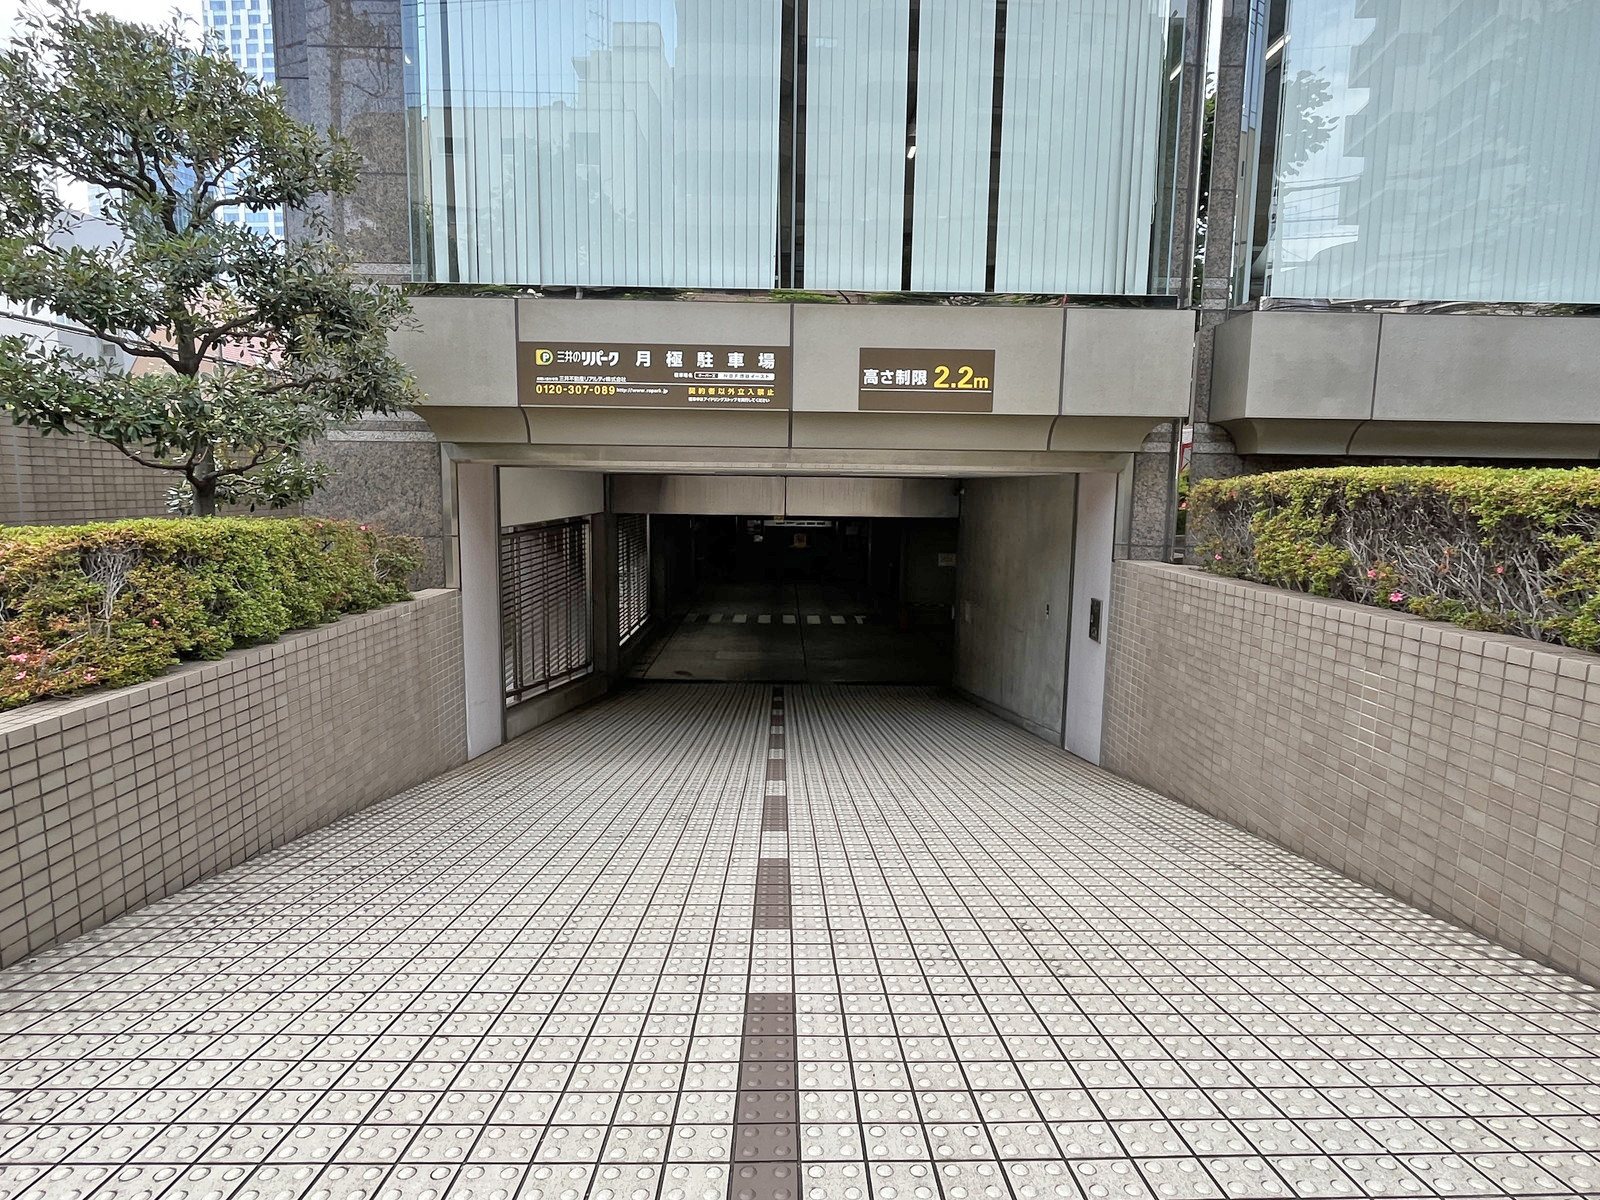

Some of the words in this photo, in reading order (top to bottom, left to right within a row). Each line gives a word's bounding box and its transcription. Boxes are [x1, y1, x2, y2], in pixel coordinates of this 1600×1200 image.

[557, 350, 619, 366] 三井のリパーク
[635, 350, 776, 369] 月極駐車場
[863, 368, 928, 386] 高さ制限
[933, 364, 990, 389] 2.2m
[536, 384, 616, 394] 0120-307-089
